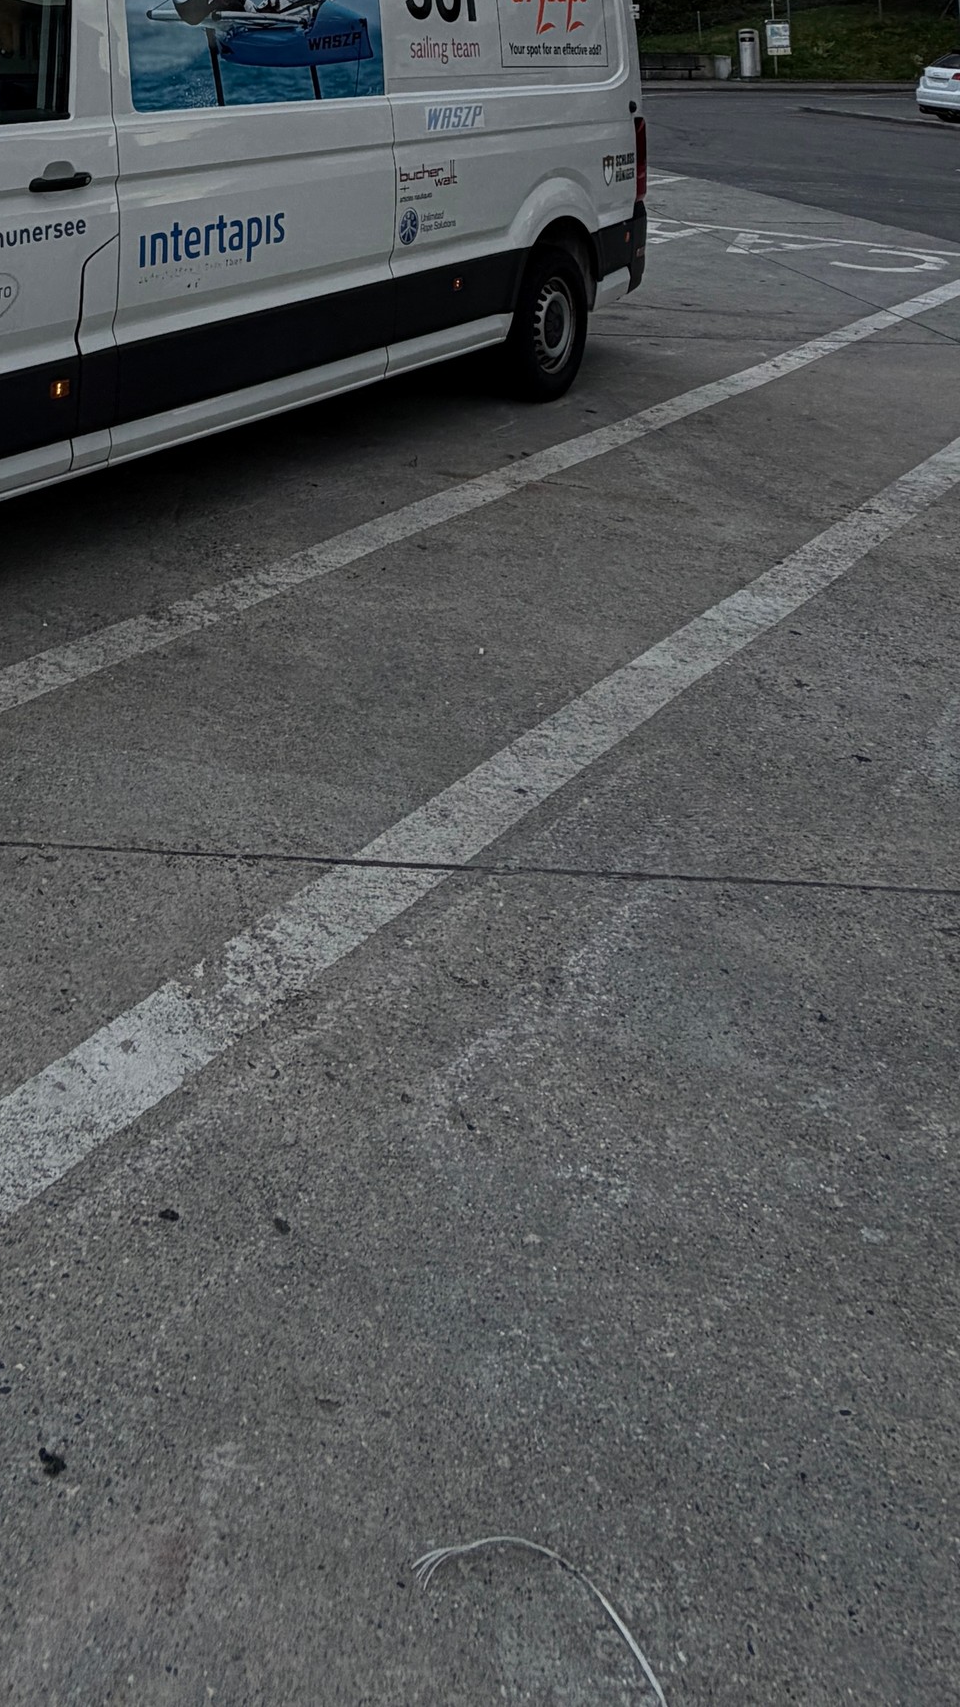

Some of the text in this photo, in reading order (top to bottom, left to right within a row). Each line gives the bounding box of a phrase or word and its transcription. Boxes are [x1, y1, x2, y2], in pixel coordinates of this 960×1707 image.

[308, 32, 362, 51] WASZP
[410, 35, 481, 64] sailing team
[509, 42, 602, 58] Your spot for an effective add?
[427, 105, 483, 130] WASZP
[399, 164, 444, 183] bucher
[420, 210, 444, 222] Unlimited
[420, 220, 456, 233] Rope Solutions
[139, 211, 286, 268] intertapis
